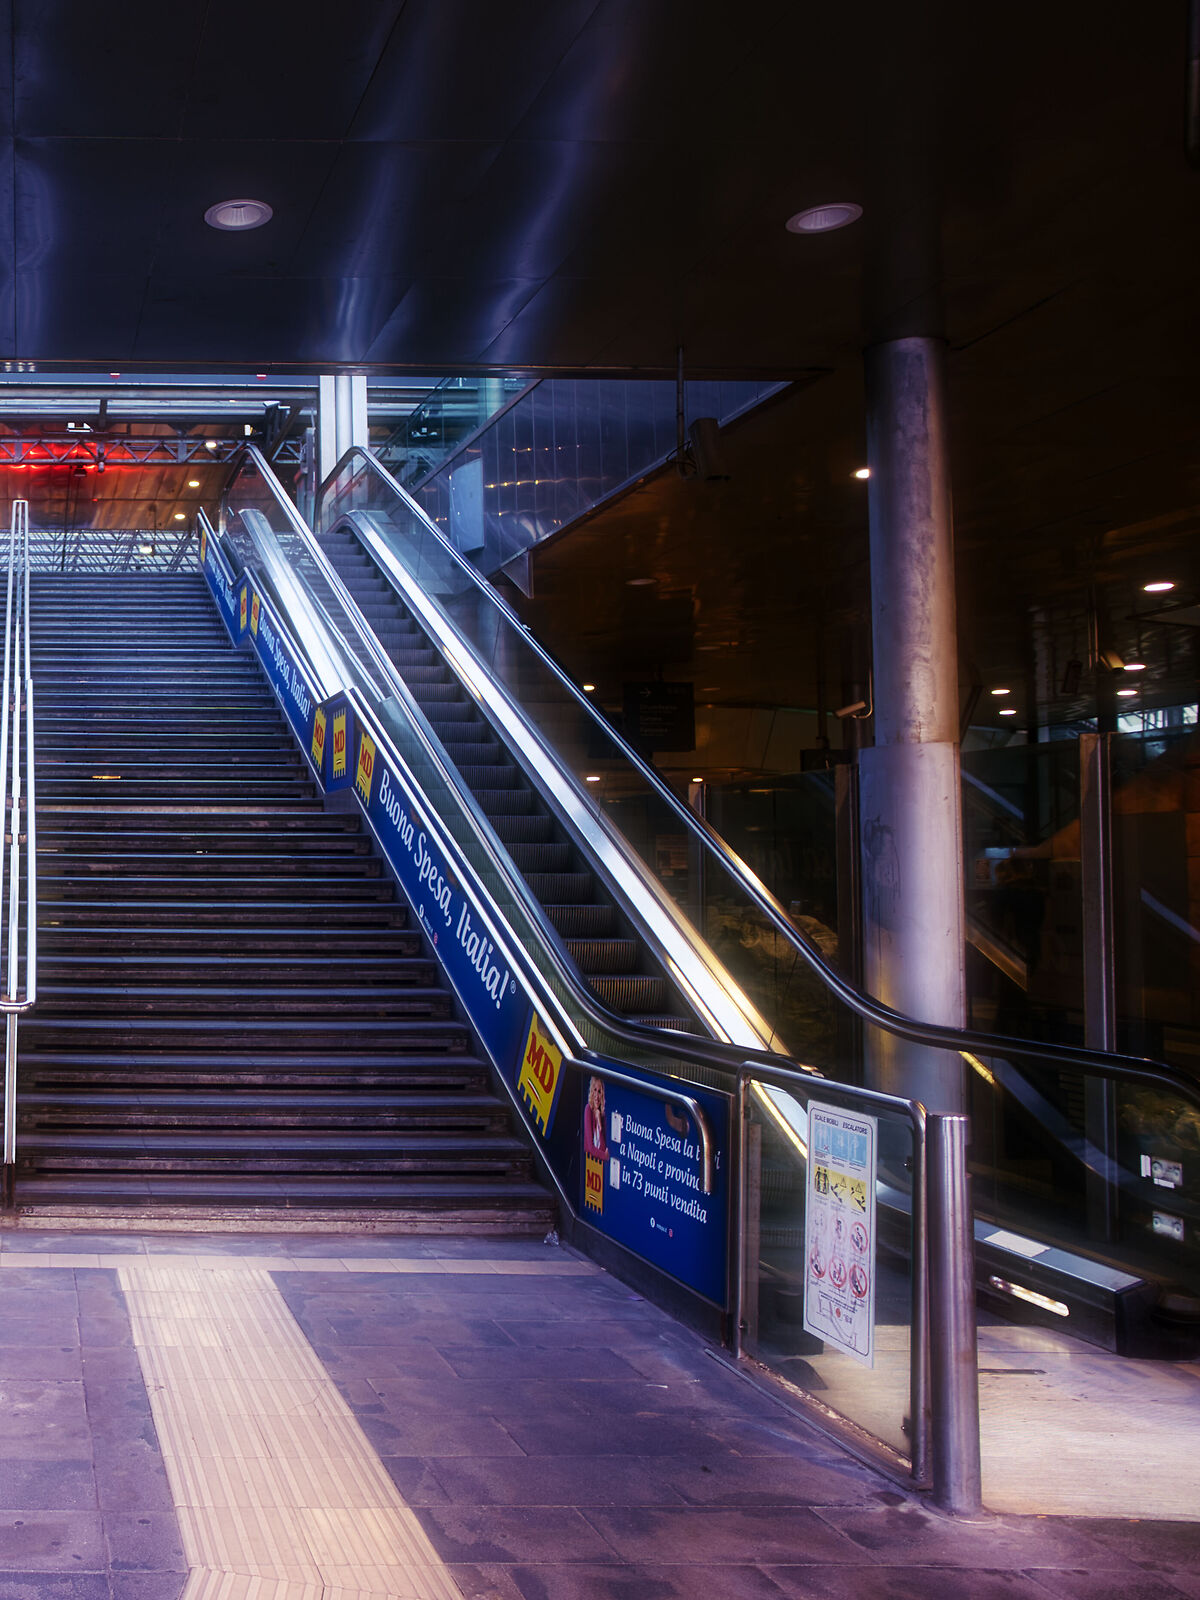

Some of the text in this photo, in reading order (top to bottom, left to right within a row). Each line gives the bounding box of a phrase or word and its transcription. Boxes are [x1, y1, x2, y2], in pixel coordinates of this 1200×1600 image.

[313, 721, 324, 747] MD
[334, 730, 345, 755] MD
[359, 743, 372, 778] MD
[379, 768, 509, 1009] Buona Spesa, Italia!
[526, 1030, 556, 1095] MD
[625, 1114, 653, 1141] Buona
[654, 1126, 681, 1154] Spesa
[683, 1138, 693, 1159] la
[620, 1143, 626, 1156] a
[627, 1141, 657, 1170] Napoli
[658, 1161, 663, 1174] e
[586, 1169, 601, 1193] MD
[622, 1165, 707, 1224] in 73 punti vendita
